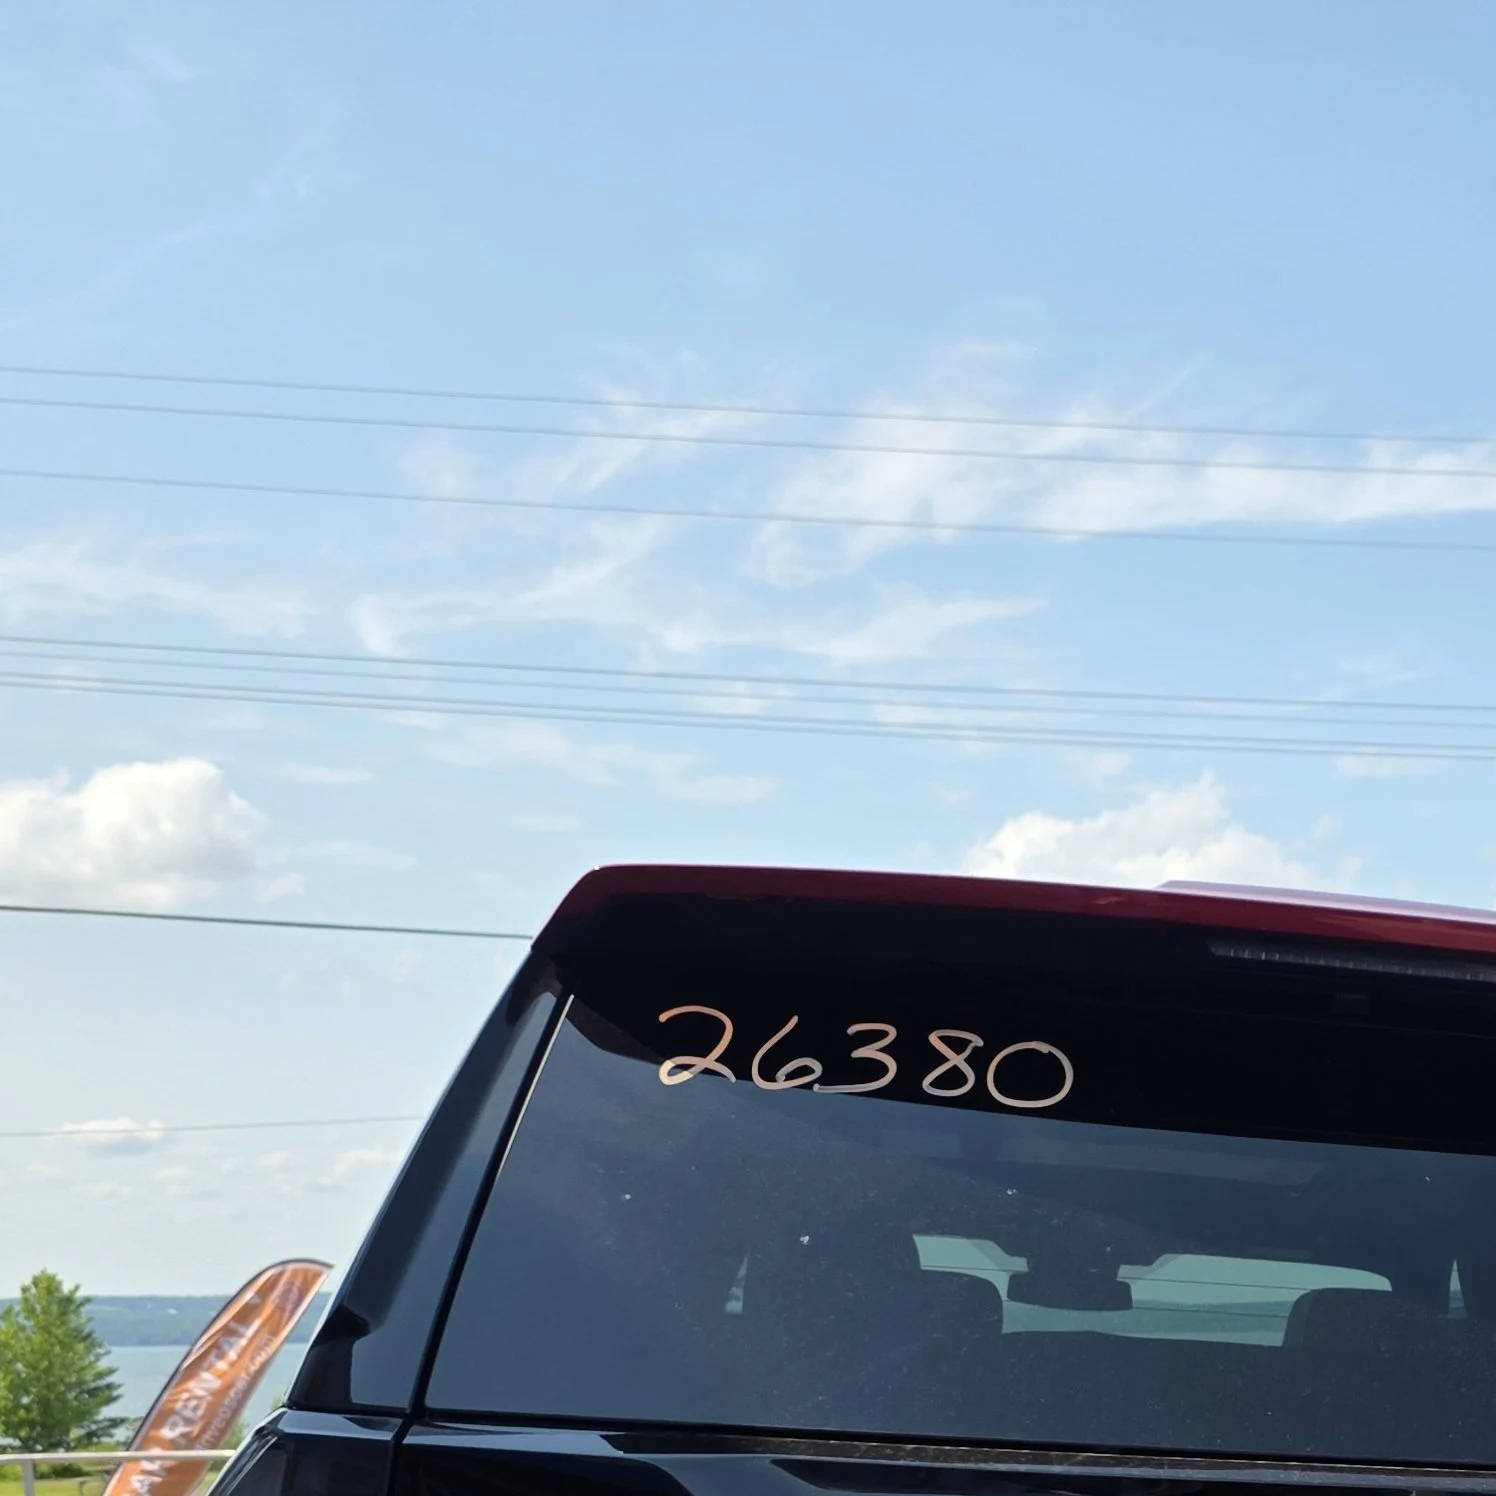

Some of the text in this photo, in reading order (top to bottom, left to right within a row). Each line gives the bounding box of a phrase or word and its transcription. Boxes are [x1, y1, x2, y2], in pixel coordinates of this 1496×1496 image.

[658, 1004, 1074, 1108] 26380
[159, 1316, 261, 1446] RENTAL
[194, 1333, 275, 1452] riveoscar.com
